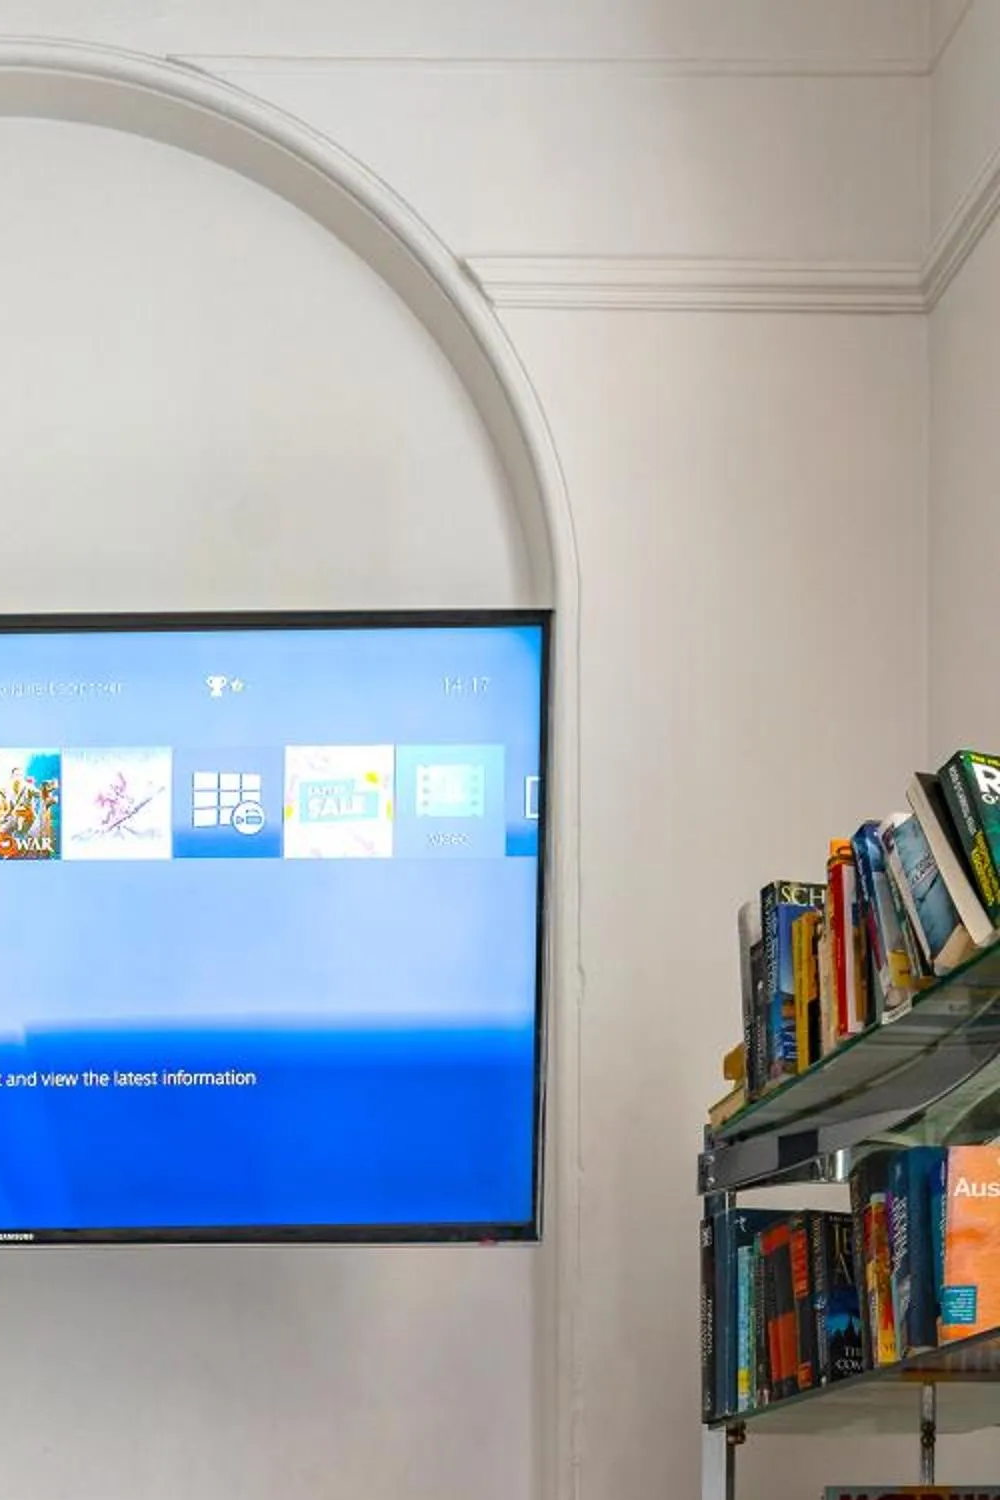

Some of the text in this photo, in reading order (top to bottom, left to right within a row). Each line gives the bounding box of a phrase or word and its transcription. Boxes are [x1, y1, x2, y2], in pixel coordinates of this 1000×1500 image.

[15, 837, 53, 852] WAR
[6, 1071, 37, 1087] and
[41, 1072, 78, 1087] view
[82, 1070, 109, 1087] the
[113, 1070, 157, 1087] latest
[161, 1069, 257, 1087] information
